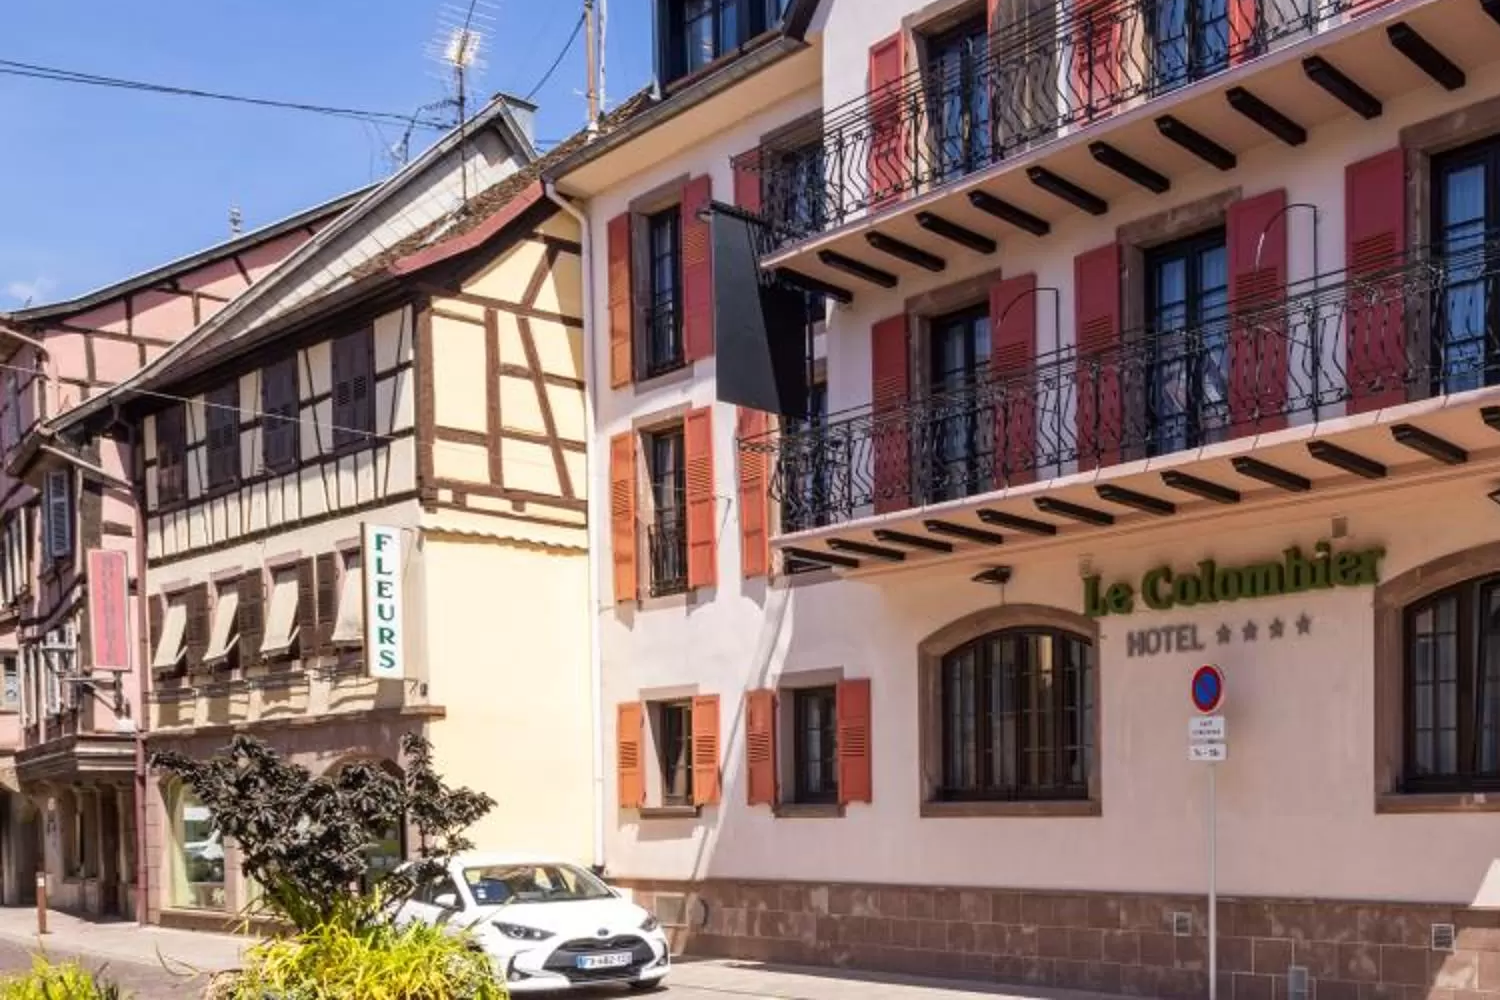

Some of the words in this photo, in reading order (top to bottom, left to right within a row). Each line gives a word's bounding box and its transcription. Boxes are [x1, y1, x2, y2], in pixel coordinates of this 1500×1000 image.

[375, 533, 395, 668] FLEURS
[1082, 574, 1135, 617] Le
[1141, 541, 1387, 610] Colombier
[1126, 623, 1205, 657] HOTEL
